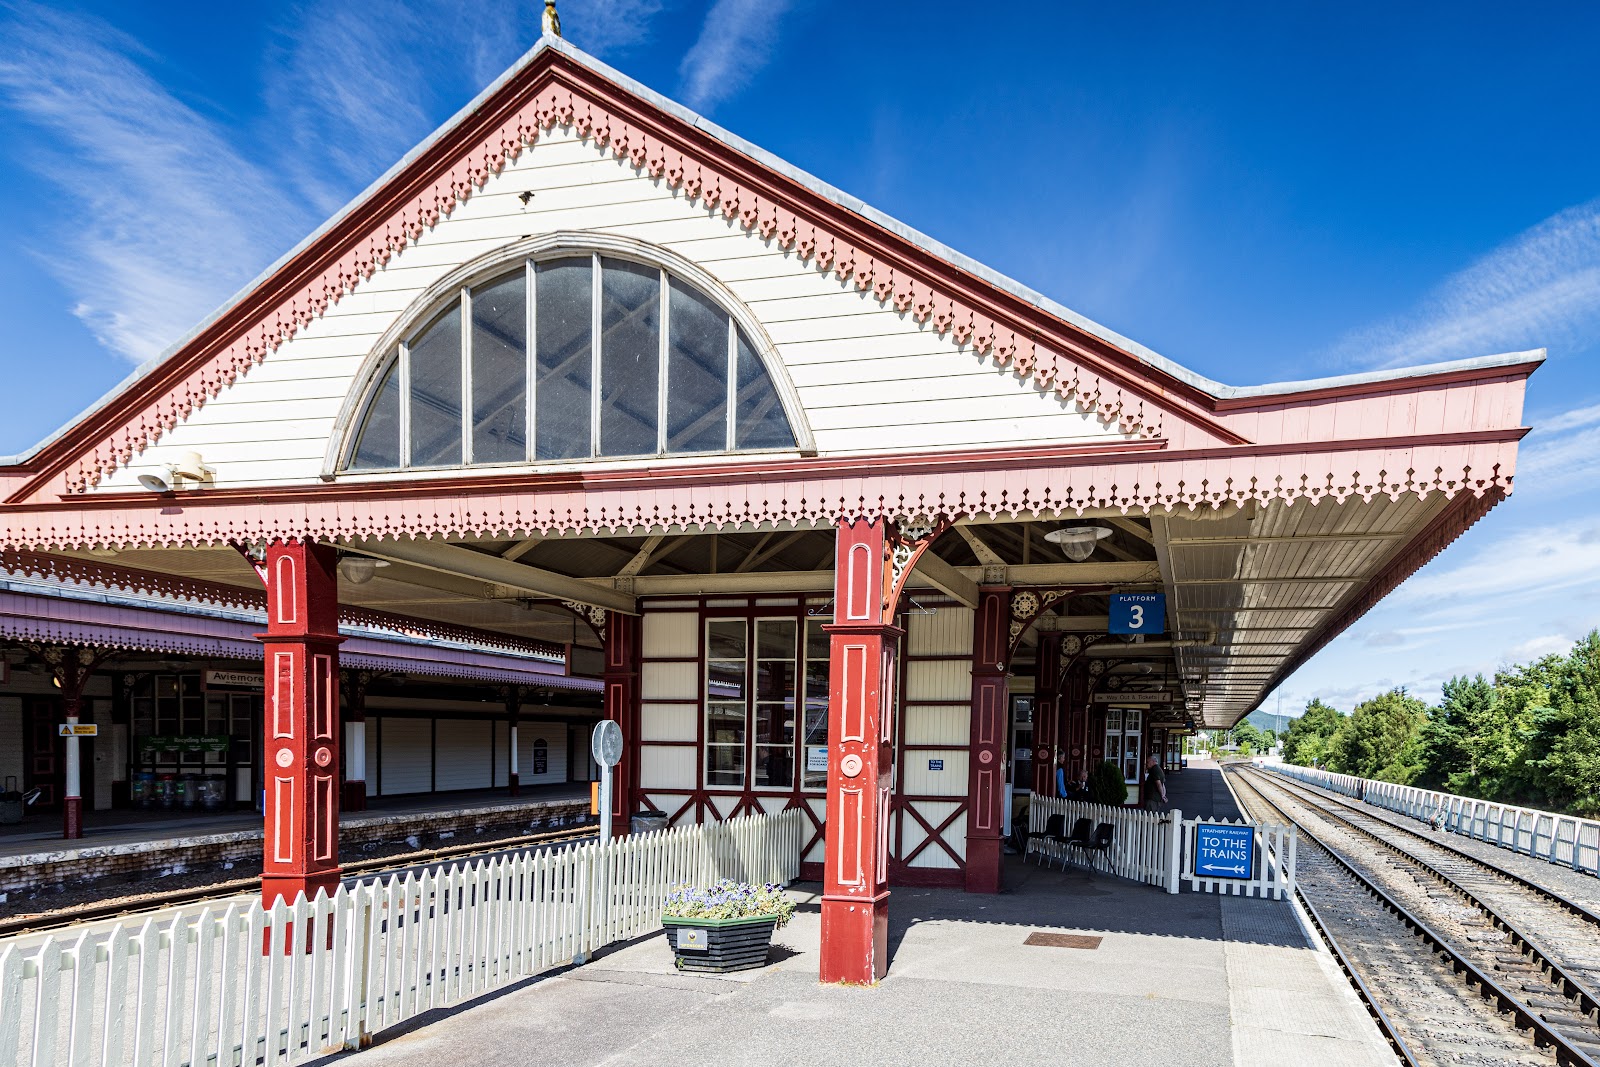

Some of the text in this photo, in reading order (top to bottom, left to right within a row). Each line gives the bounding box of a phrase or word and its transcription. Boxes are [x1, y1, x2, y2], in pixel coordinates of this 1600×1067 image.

[1128, 605, 1144, 629] 3
[213, 672, 264, 683] Aviemore
[173, 736, 199, 744] Recycling
[1202, 836, 1246, 849] TO THE
[1202, 848, 1246, 860] TRAINS
